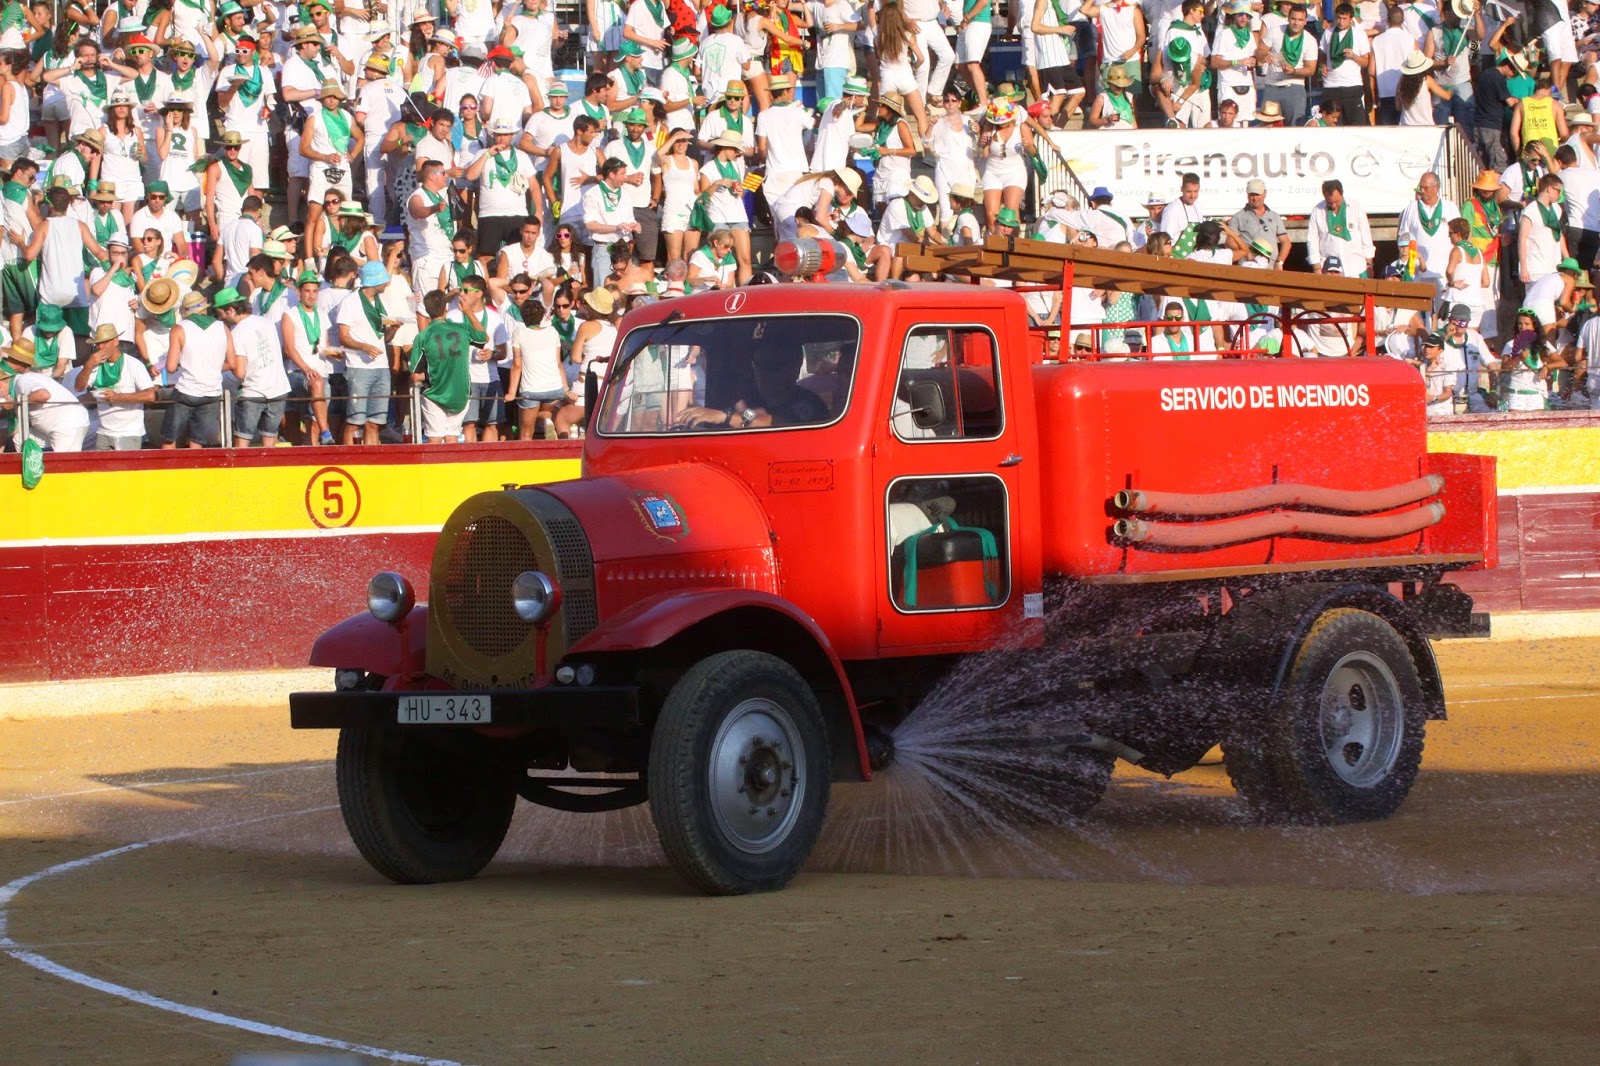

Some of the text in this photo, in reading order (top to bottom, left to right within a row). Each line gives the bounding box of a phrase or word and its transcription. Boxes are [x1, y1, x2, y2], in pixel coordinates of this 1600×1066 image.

[1115, 143, 1335, 180] Pirenauto
[730, 293, 741, 310] 1
[435, 331, 462, 360] 12
[1160, 384, 1370, 411] SERVICIO DE INCENDIOS
[323, 480, 344, 519] 5
[408, 698, 481, 721] HU-343
